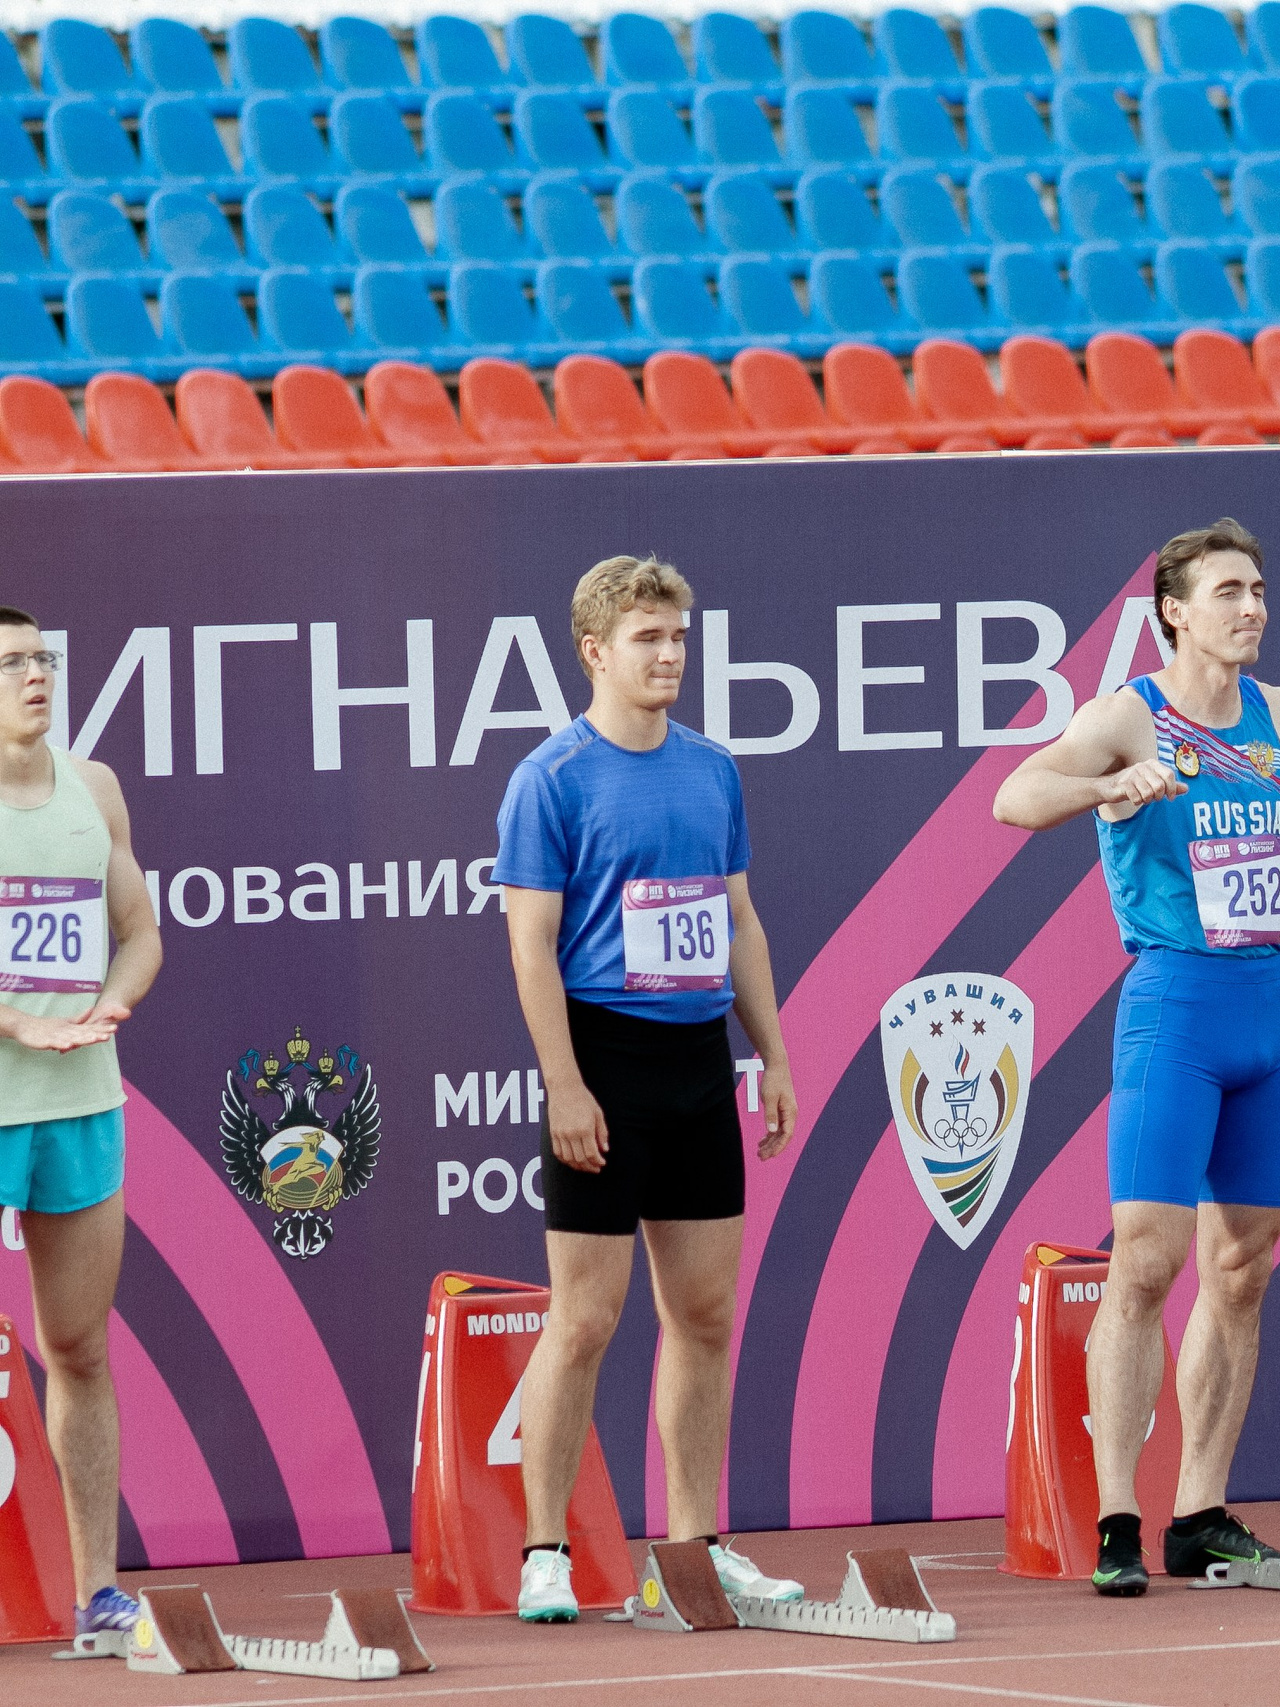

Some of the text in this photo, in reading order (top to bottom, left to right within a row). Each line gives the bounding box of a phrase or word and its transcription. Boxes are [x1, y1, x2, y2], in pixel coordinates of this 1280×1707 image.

[40, 596, 1178, 777] ИГНАЬЕВ
[145, 857, 508, 928] ования
[11, 912, 82, 963] 226
[658, 910, 715, 962] 136
[888, 983, 1023, 1029] ЧУВАШИЯ
